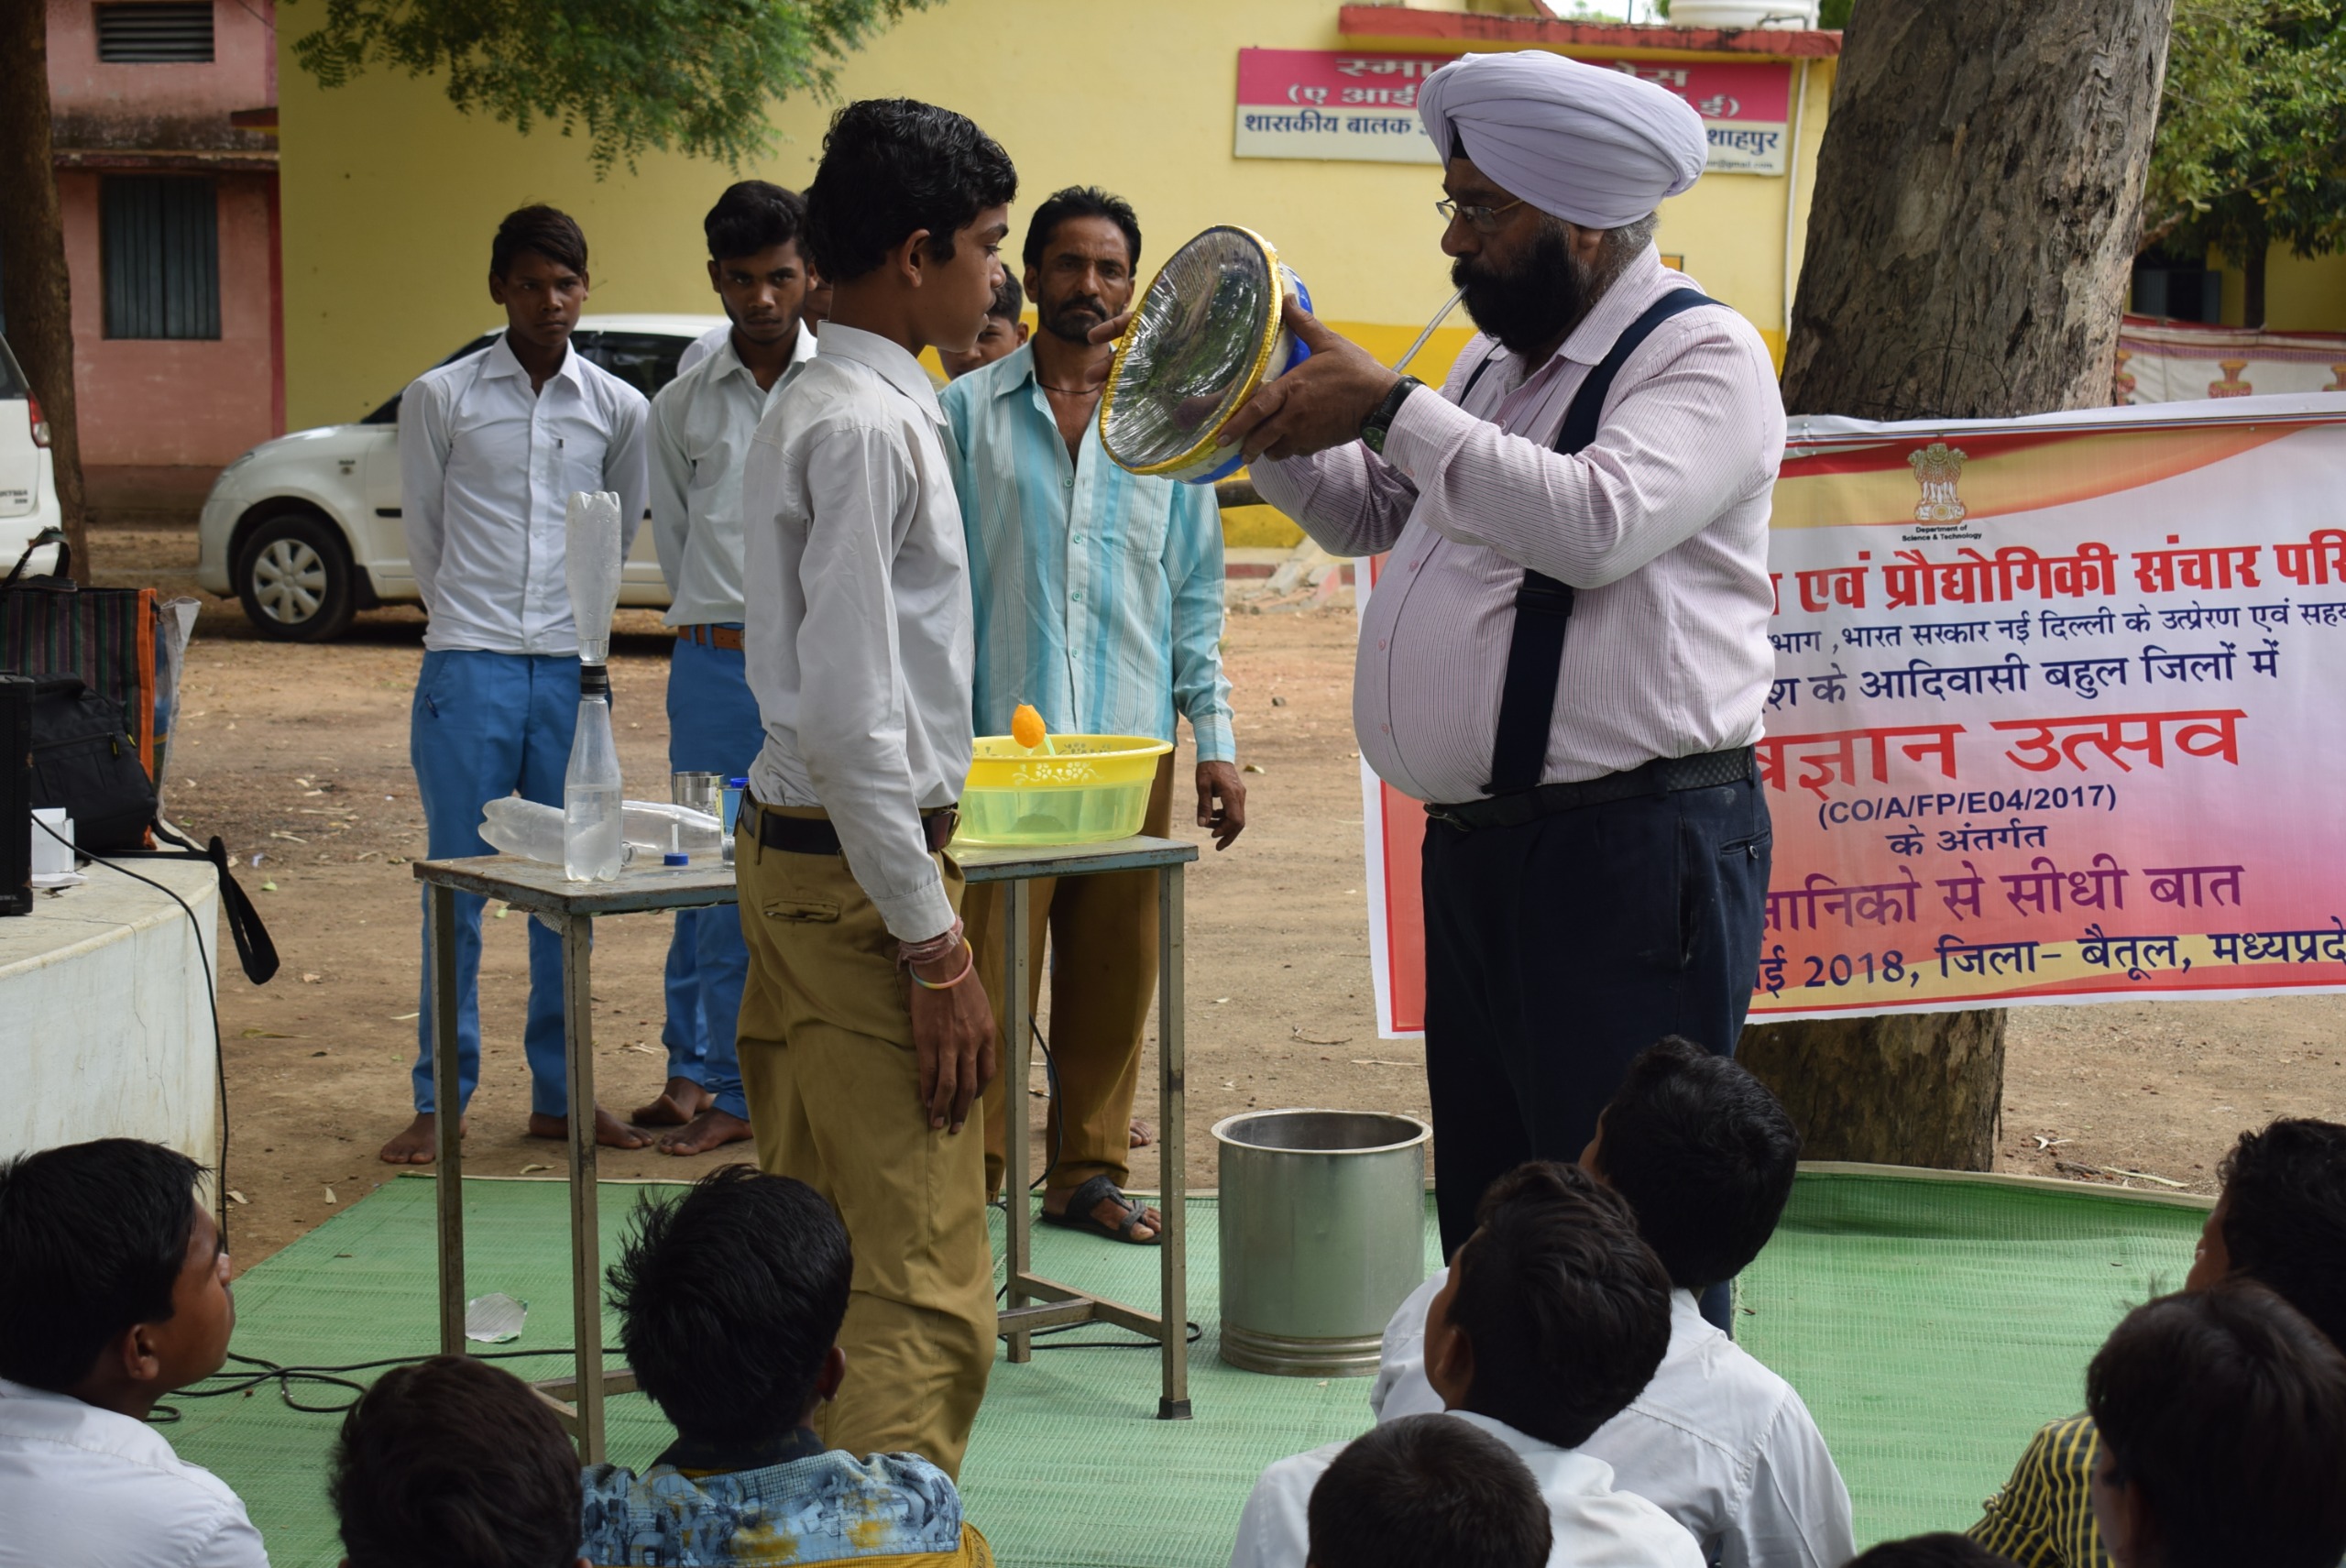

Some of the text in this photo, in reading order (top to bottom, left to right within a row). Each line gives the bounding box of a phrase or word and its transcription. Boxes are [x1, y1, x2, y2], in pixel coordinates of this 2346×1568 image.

[1244, 108, 1339, 135] शासकीय
[1347, 115, 1412, 135] बालक
[1706, 127, 1779, 156] शाहपुर
[1915, 525, 1958, 534] Department
[1940, 532, 1982, 541] Technology
[1794, 551, 1869, 613] एवं
[1881, 542, 2119, 611] प्रौद्योगिकी
[2131, 534, 2262, 594] संचार
[1909, 620, 1991, 648] सरकार
[1994, 610, 2031, 645] नई
[2038, 606, 2117, 641] दिल्ली
[2121, 604, 2152, 633] के
[2157, 600, 2242, 630] उत्प्रेरण
[2248, 598, 2290, 633] एवं
[1807, 662, 1848, 704] के
[1858, 652, 2031, 702] आदिवासी
[2040, 657, 2130, 700] बहुल
[2139, 641, 2238, 685] जिलों
[2247, 639, 2281, 679] में
[1989, 708, 2249, 773] उत्सव
[1818, 784, 2117, 831] (CO/A/FP/E04/2017)
[1884, 818, 2049, 857] के अंतर्गत
[1935, 860, 1987, 922] से
[1998, 853, 2130, 917] सीधी
[2142, 865, 2245, 909] बात
[1803, 949, 1920, 988] 2018,
[2076, 923, 2192, 981] बैतूल,
[2206, 915, 2346, 968] मध्यप्रदे
